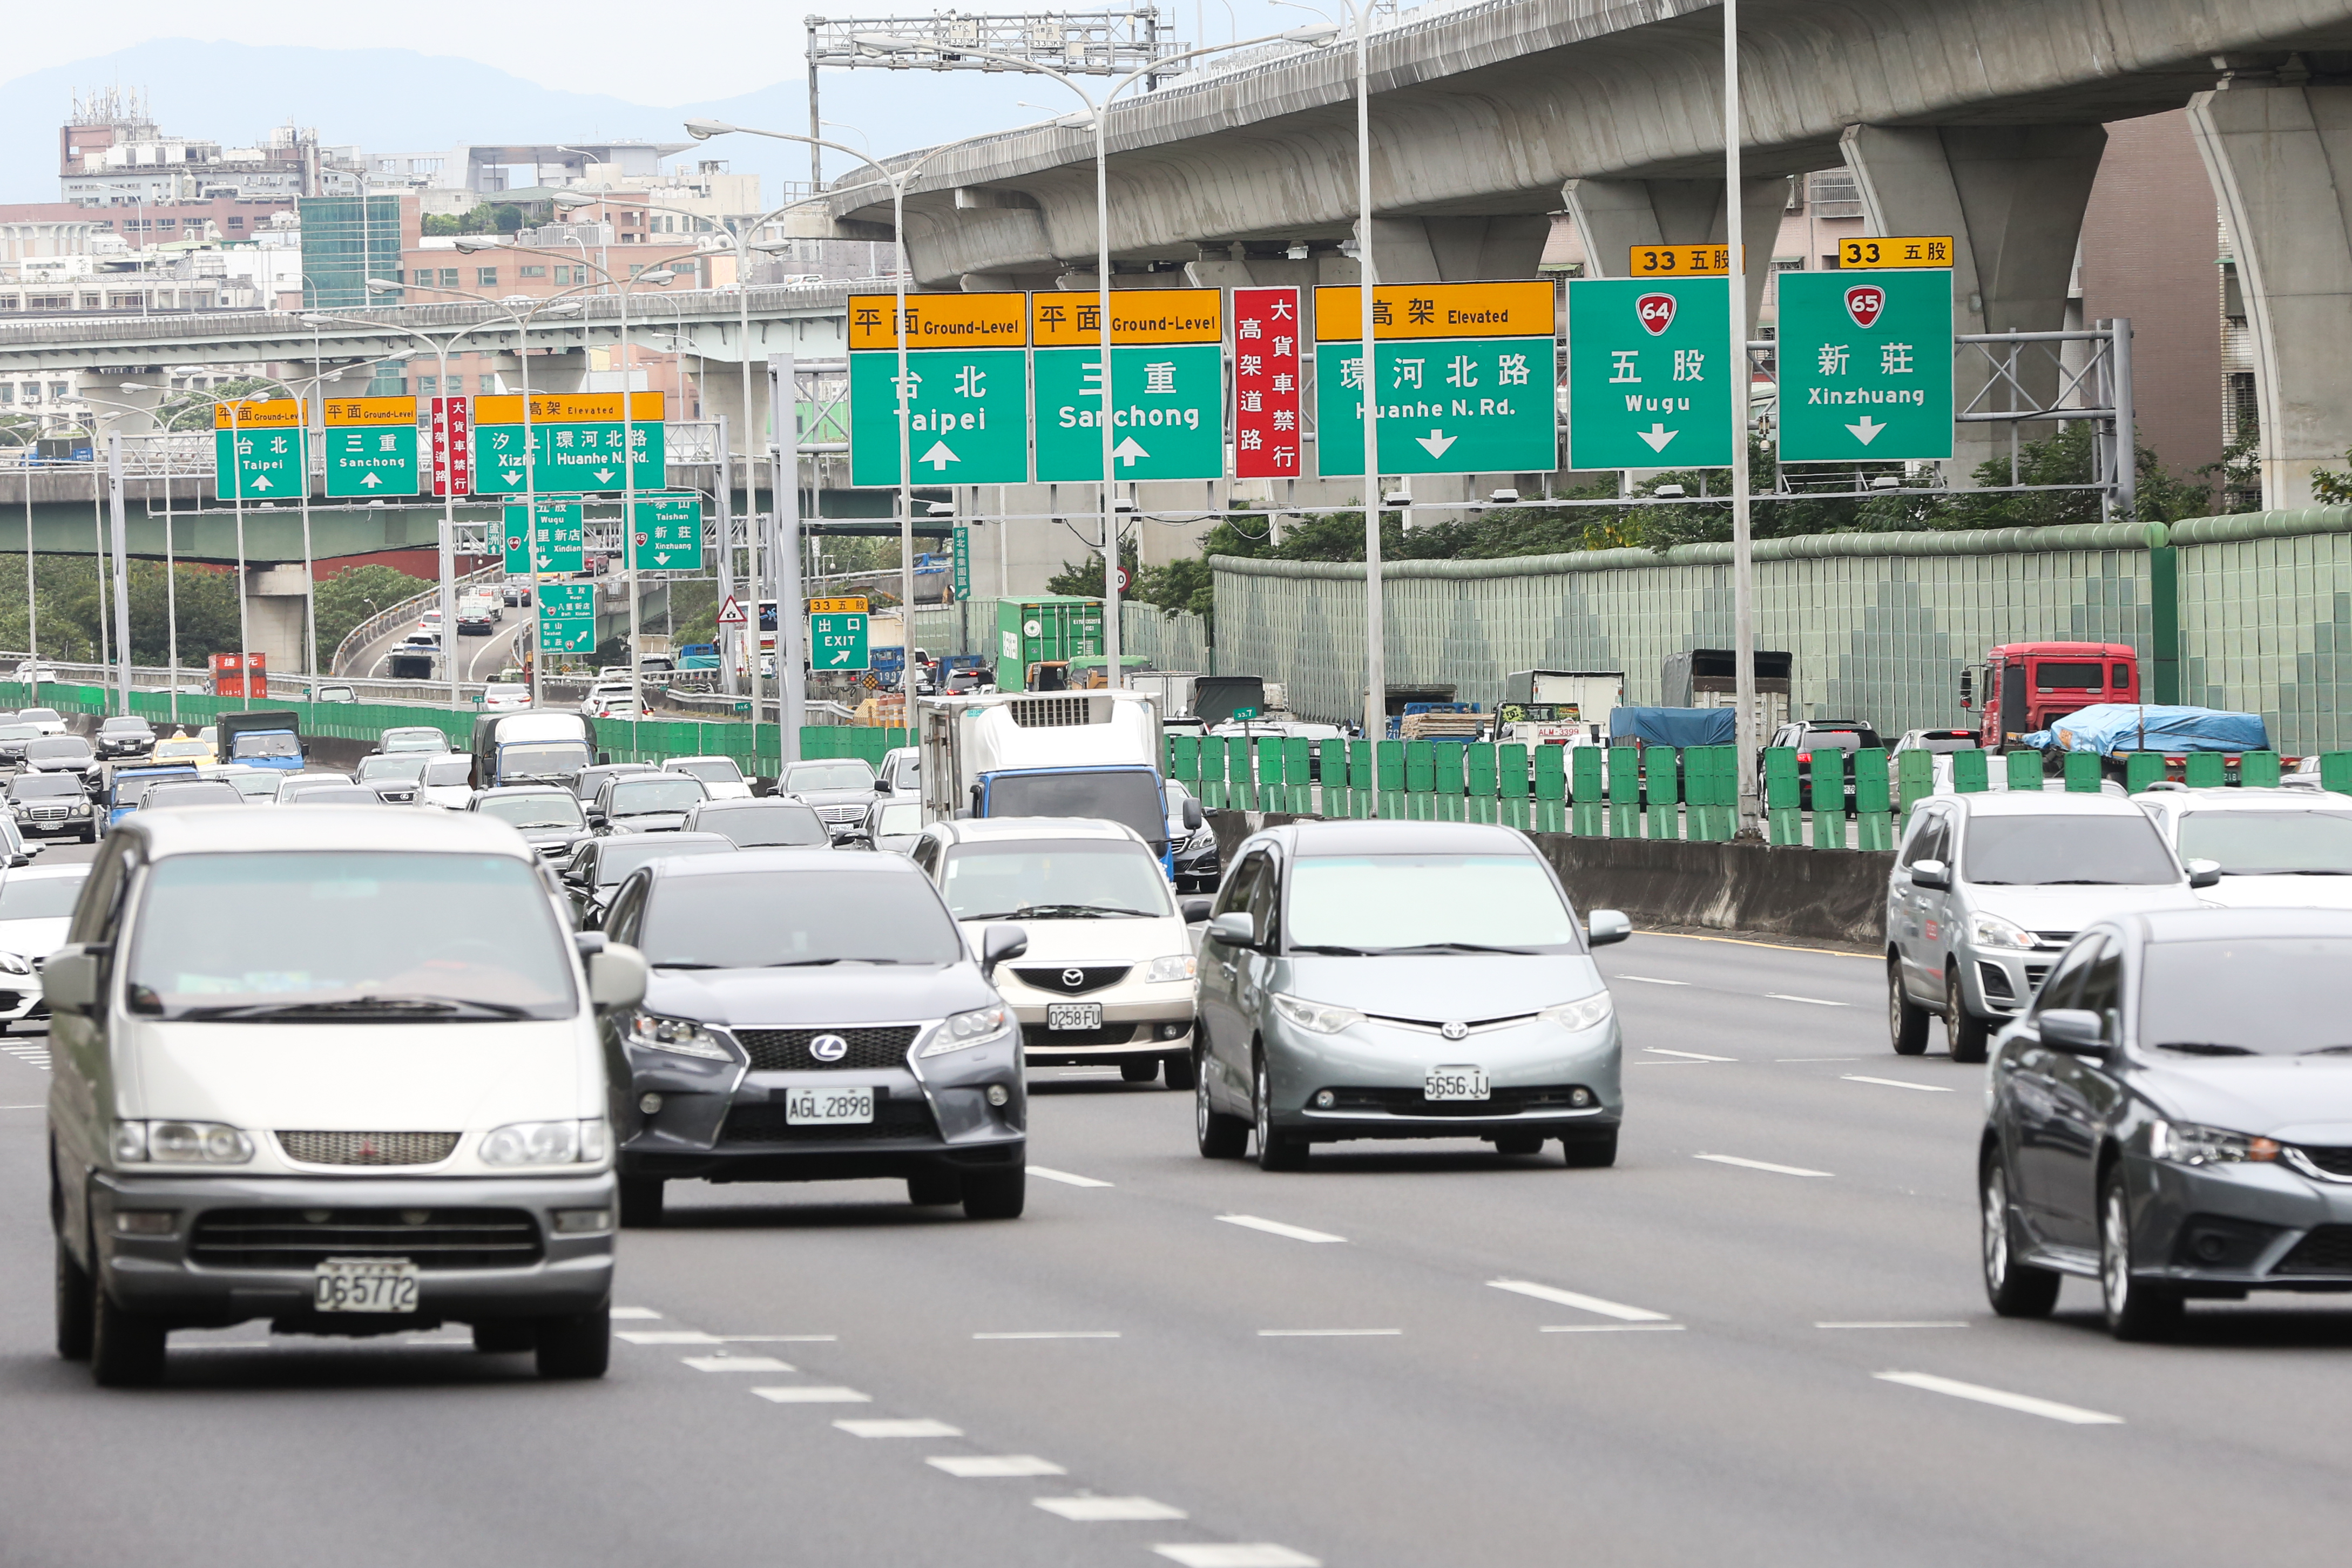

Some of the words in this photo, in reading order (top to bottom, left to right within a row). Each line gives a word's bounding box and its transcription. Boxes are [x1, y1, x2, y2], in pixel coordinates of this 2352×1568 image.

[1643, 252, 1675, 271] 33
[1690, 250, 1729, 270] 五股
[1847, 244, 1881, 263] 33
[1905, 242, 1946, 261] 五股
[1373, 298, 1435, 326] 高架
[1448, 310, 1509, 324] Elevated
[1642, 303, 1669, 320] 64
[1851, 295, 1878, 312] 65
[855, 308, 919, 336] 平面
[924, 320, 1018, 335] Ground-Level
[1039, 305, 1100, 333] 平面
[1112, 316, 1215, 332] Ground-Level
[1608, 349, 1705, 383] 五股
[1818, 342, 1914, 376] 新莊
[1079, 362, 1177, 396] 三重
[1340, 353, 1530, 390] 環河北路
[890, 366, 986, 399] 台北
[1239, 318, 1262, 450] 高架道路
[1270, 299, 1295, 468] 大貨車禁行
[1625, 395, 1690, 415] Wugu
[1808, 386, 1924, 407] Xinzhuang
[219, 407, 252, 422] 平面
[254, 412, 304, 421] Ground-Levl
[327, 404, 361, 419] 平面
[364, 410, 414, 418] Ground-Level
[529, 401, 561, 416] 高架
[1452, 400, 1474, 415] N.
[1481, 398, 1515, 415] Rd.
[237, 436, 287, 455] 台北
[346, 434, 397, 452] 三重
[452, 402, 467, 490] 大貨車禁行
[556, 430, 647, 449] 環河北路
[243, 460, 283, 471] Taipei
[340, 457, 404, 468] Sanchong
[557, 452, 608, 465] Huanhe
[540, 516, 564, 525] Wugu
[654, 526, 691, 539] 新莊
[655, 542, 692, 551] Xinzhuang
[956, 530, 967, 586] 新北產業園區
[813, 601, 830, 610] 33
[838, 600, 865, 610] 五股
[819, 618, 861, 633] 出口
[824, 636, 856, 646] EXIT
[1238, 709, 1252, 718] 33.7
